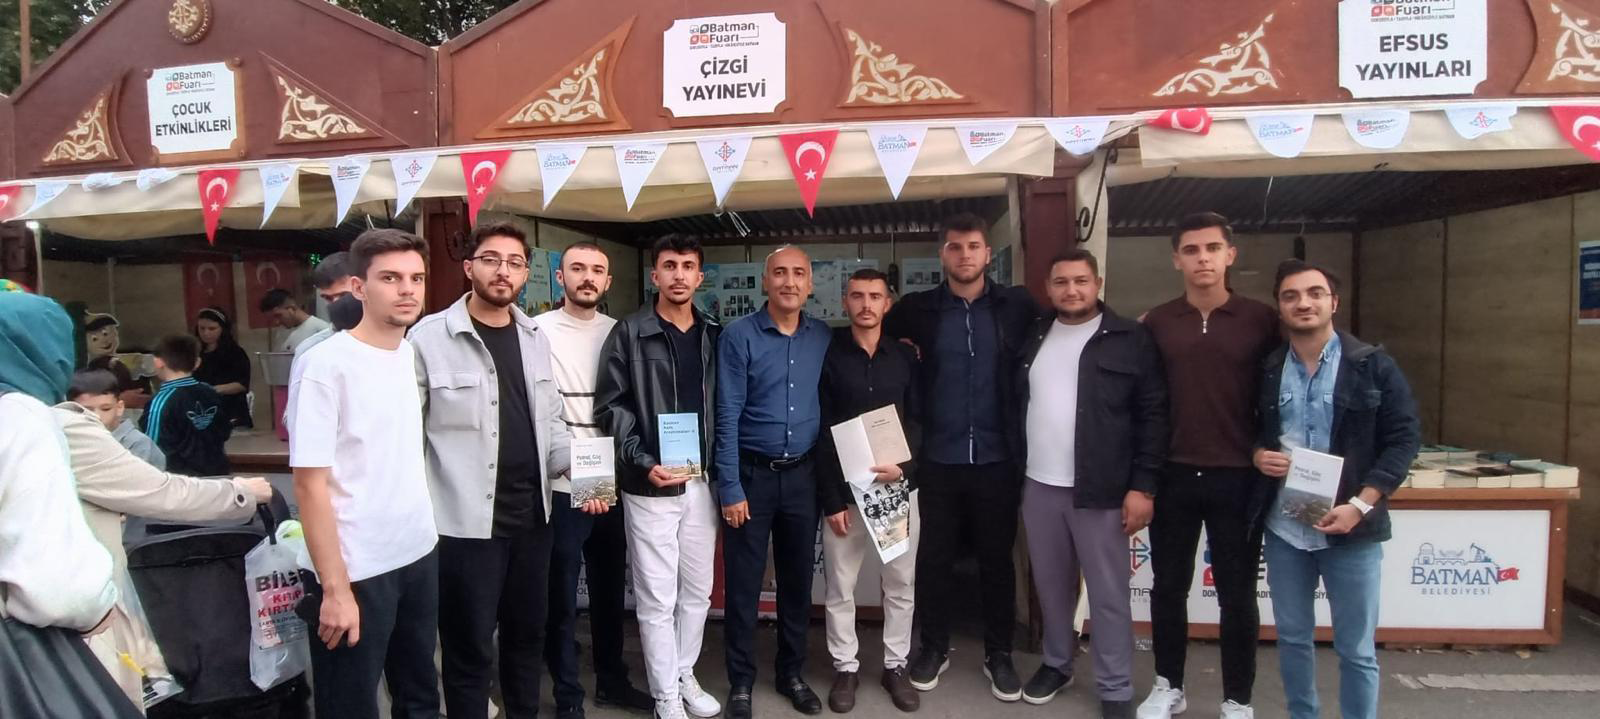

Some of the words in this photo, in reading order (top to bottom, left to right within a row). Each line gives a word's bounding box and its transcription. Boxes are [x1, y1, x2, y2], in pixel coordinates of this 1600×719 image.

[1395, 5, 1431, 15] Fuarı
[709, 22, 755, 33] Batman
[709, 33, 739, 43] Fuarı
[1379, 33, 1449, 53] EFSUS
[179, 70, 212, 80] Batman
[700, 55, 748, 79] ÇİZGİ
[1355, 60, 1471, 81] YAYINLARI
[179, 81, 201, 89] Fuarı
[681, 78, 766, 102] YAYINEVİ
[171, 101, 212, 118] ÇOCUK
[155, 116, 232, 137] ETKİNLİKLERİ
[1411, 566, 1501, 585] BATMAN
[1421, 587, 1491, 596] BELEDİYESİ
